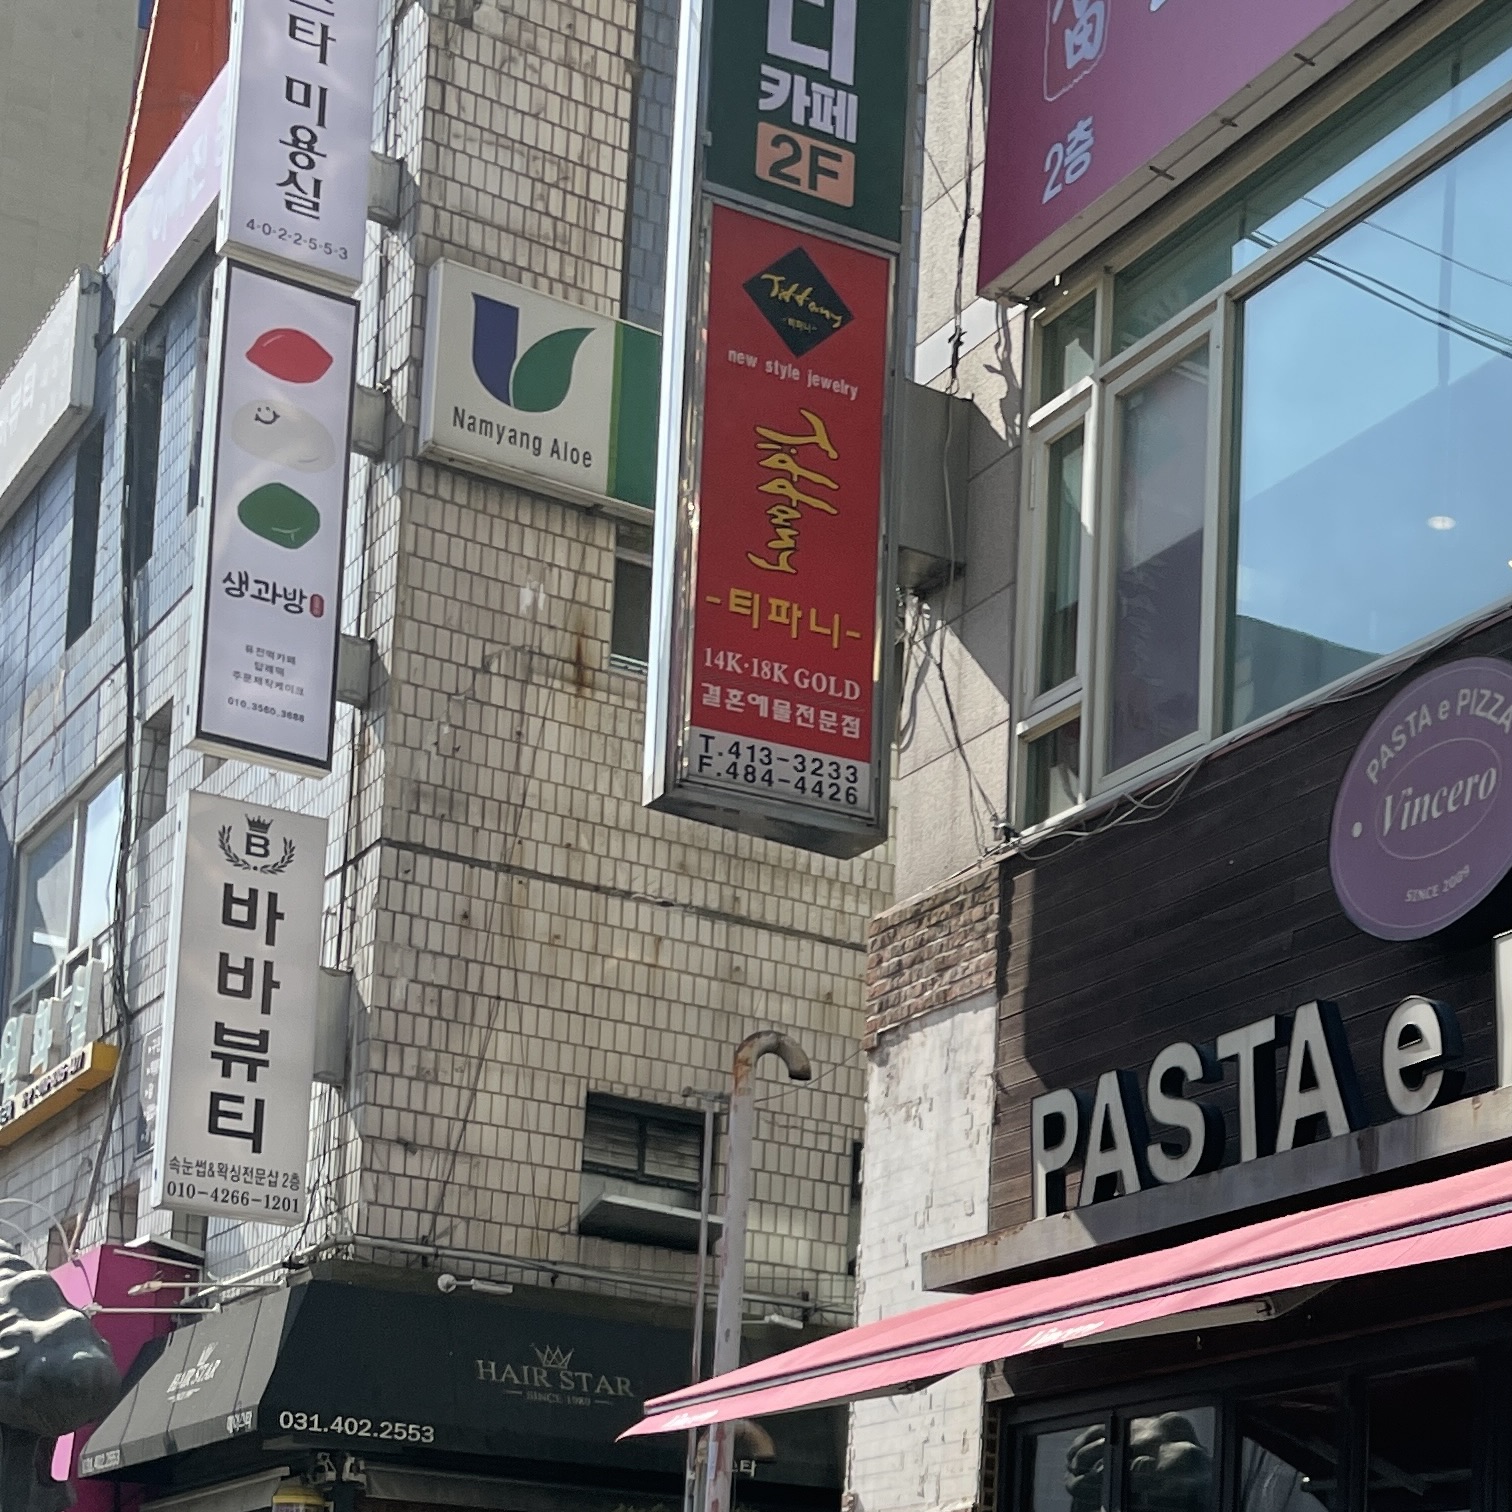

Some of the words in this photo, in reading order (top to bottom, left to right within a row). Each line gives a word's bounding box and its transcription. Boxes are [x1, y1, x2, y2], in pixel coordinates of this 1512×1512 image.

[758, 63, 859, 144] 카페
[275, 75, 328, 220] 미용실
[768, 134, 843, 192] 2F
[1042, 115, 1095, 205] 2층
[728, 349, 758, 368] new
[765, 359, 801, 381] style
[807, 369, 859, 401] jewelry
[452, 406, 544, 458] Namyang
[550, 438, 593, 468] Aloe
[222, 570, 308, 615] 생과방
[701, 682, 861, 739] 결혼예물전문점
[793, 667, 861, 701] GOLD
[1364, 703, 1433, 786] PASTA
[1437, 699, 1450, 721] e
[1381, 766, 1498, 838] Vincero
[245, 831, 271, 859] B
[206, 881, 286, 1155] 바바뷰티
[1031, 1000, 1352, 1220] PASTA
[1382, 995, 1446, 1117] e
[166, 1180, 300, 1214] 010-4266-1201
[281, 1172, 301, 1192] 2층
[475, 1358, 553, 1389] HAIR
[558, 1369, 635, 1398] STAR
[278, 1410, 435, 1444] 031.402.2553
